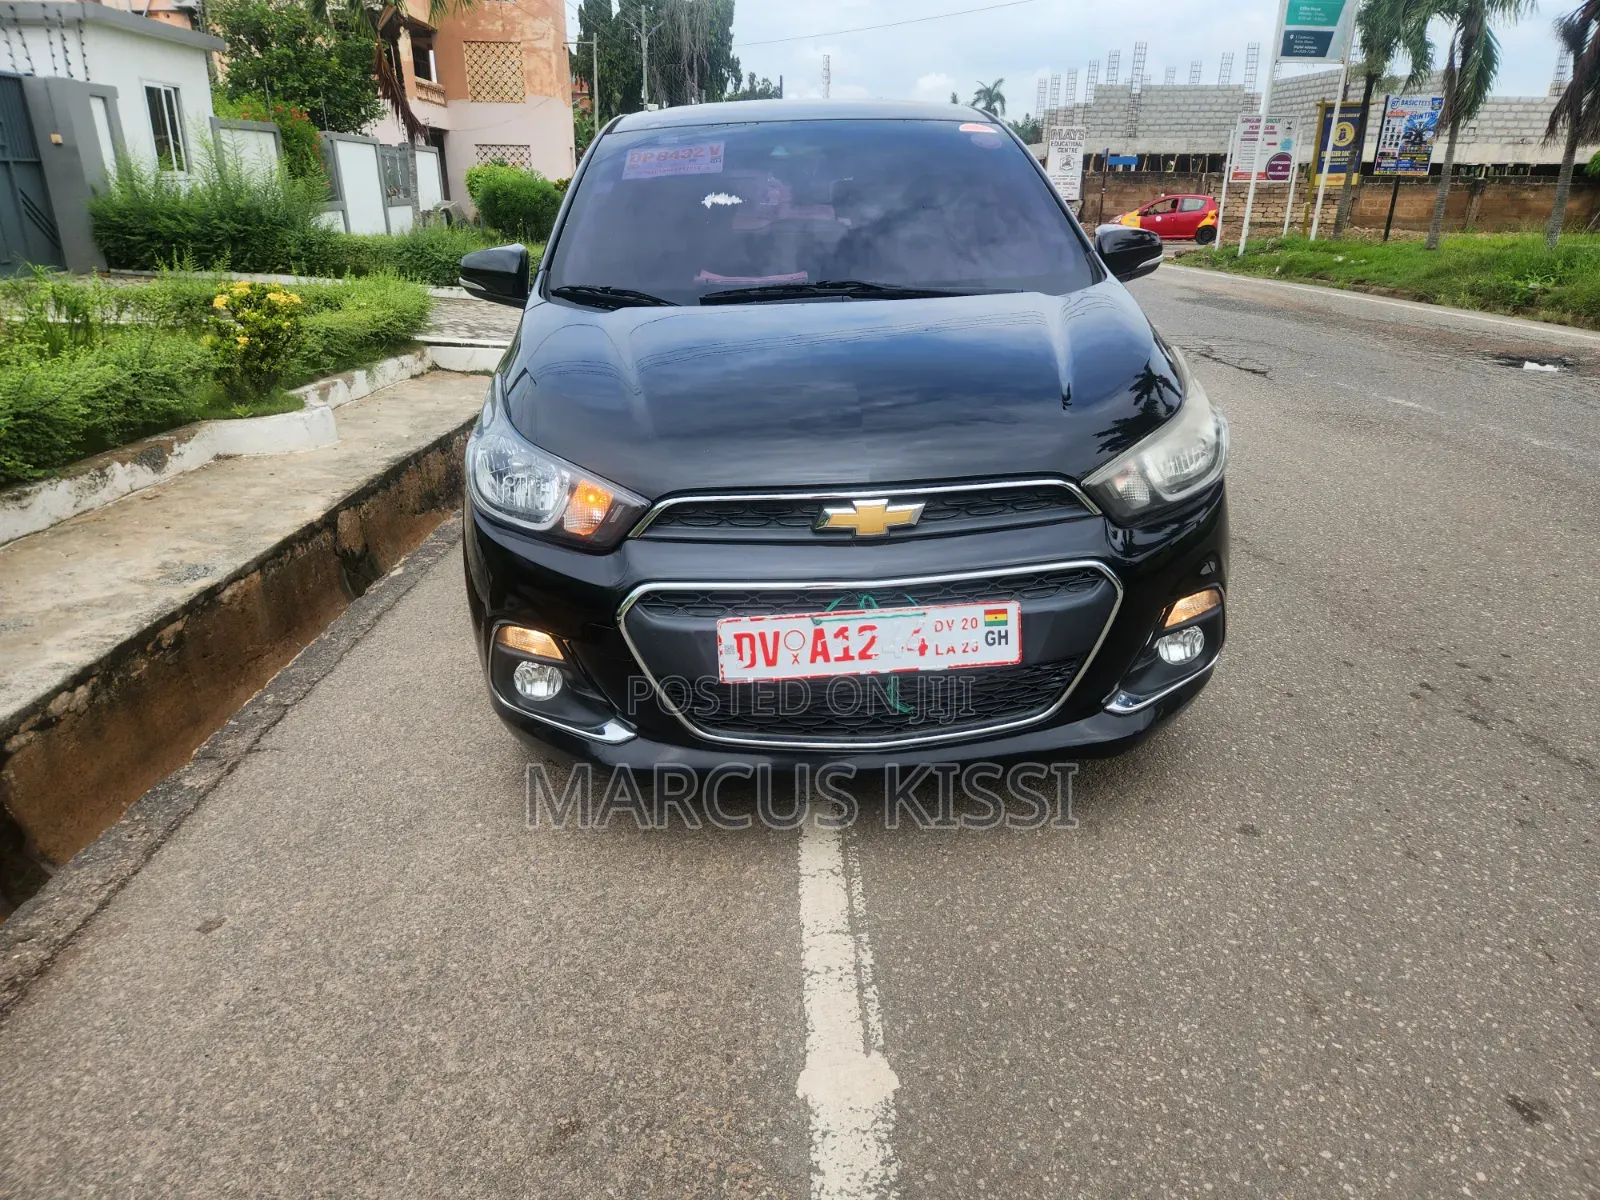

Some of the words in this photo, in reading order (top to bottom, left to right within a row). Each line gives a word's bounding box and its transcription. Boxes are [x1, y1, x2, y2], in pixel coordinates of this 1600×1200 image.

[934, 620, 955, 633] DV
[961, 617, 978, 630] 20
[984, 630, 1009, 647] GH
[733, 630, 781, 669] DV
[935, 643, 956, 656] LA
